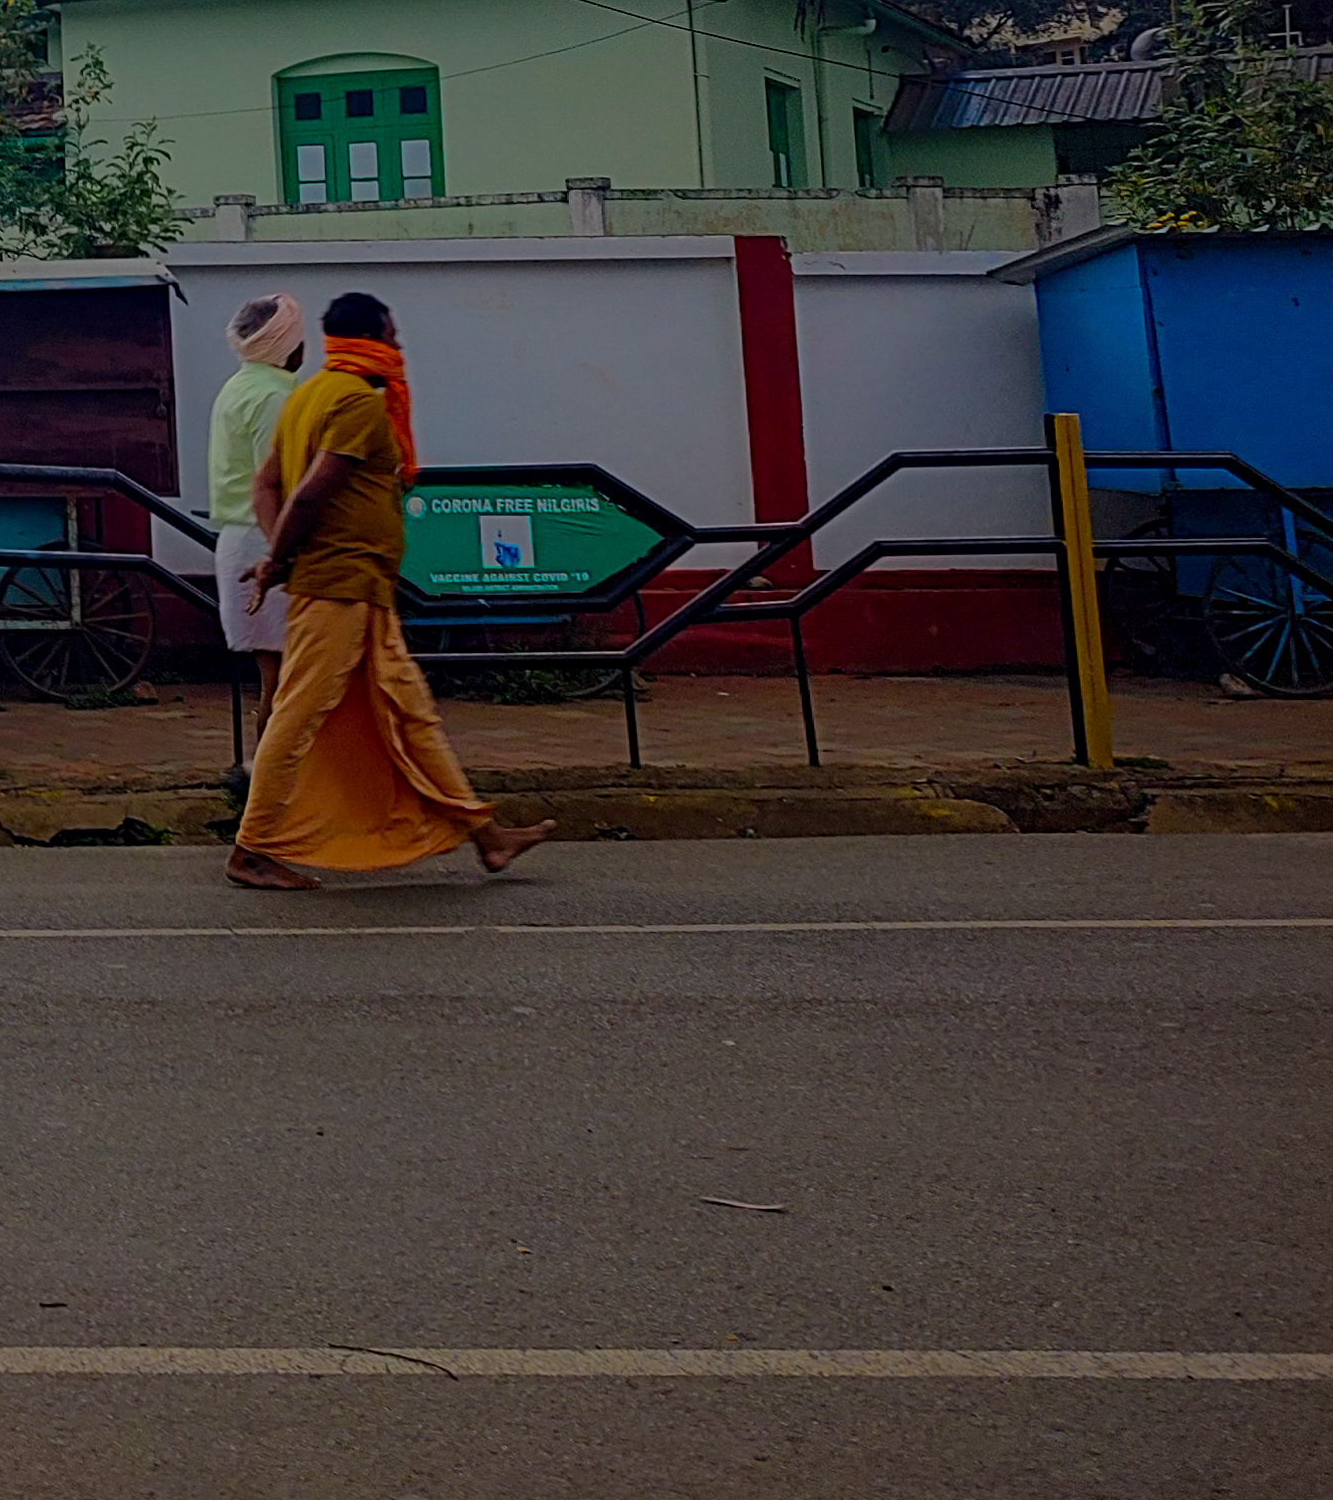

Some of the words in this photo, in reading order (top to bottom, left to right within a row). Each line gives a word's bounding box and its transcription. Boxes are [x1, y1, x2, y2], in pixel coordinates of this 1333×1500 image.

[432, 499, 492, 513] CORONA
[496, 499, 533, 513] FREE
[429, 573, 480, 583] VACCINE
[483, 573, 530, 582] AGAINST
[534, 573, 569, 582] COVID
